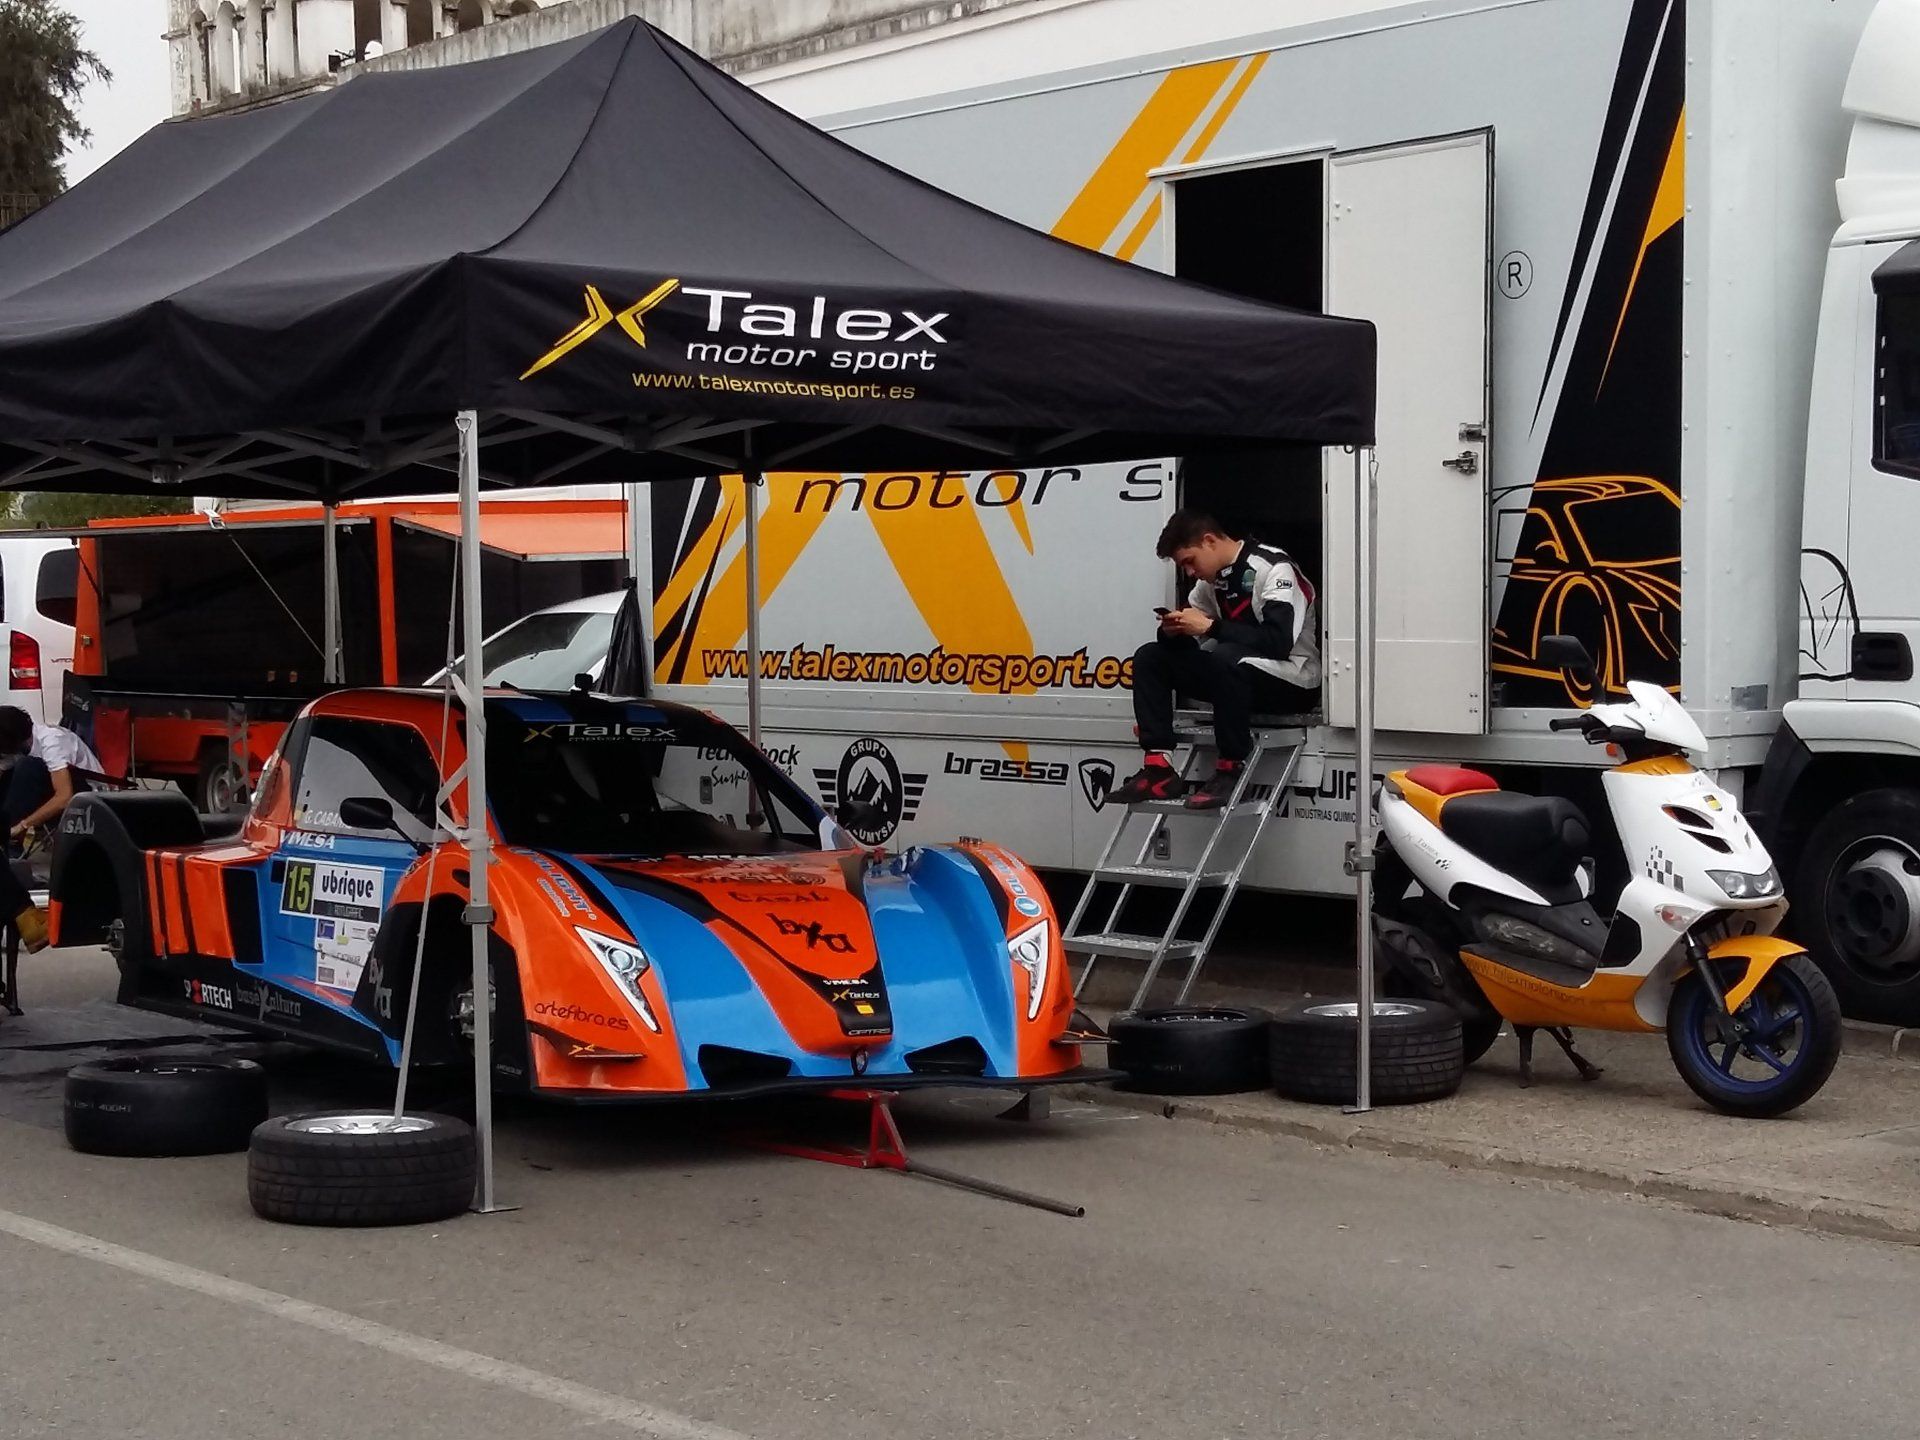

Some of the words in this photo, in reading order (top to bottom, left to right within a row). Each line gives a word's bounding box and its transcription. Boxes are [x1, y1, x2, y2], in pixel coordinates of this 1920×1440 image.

[682, 287, 950, 343] Talex
[686, 342, 816, 366] motor
[830, 347, 938, 374] sport
[632, 372, 916, 401] www.talexmotorsport.es
[794, 468, 1081, 514] motor
[557, 723, 677, 738] Talex
[850, 740, 887, 758] GRUPO
[944, 752, 1069, 781] brassa
[1294, 807, 1331, 821] INDUSTRIAS
[280, 829, 336, 850] VIMESA
[288, 865, 311, 911] 15
[321, 870, 374, 902] ubrique
[848, 991, 881, 999] Talex
